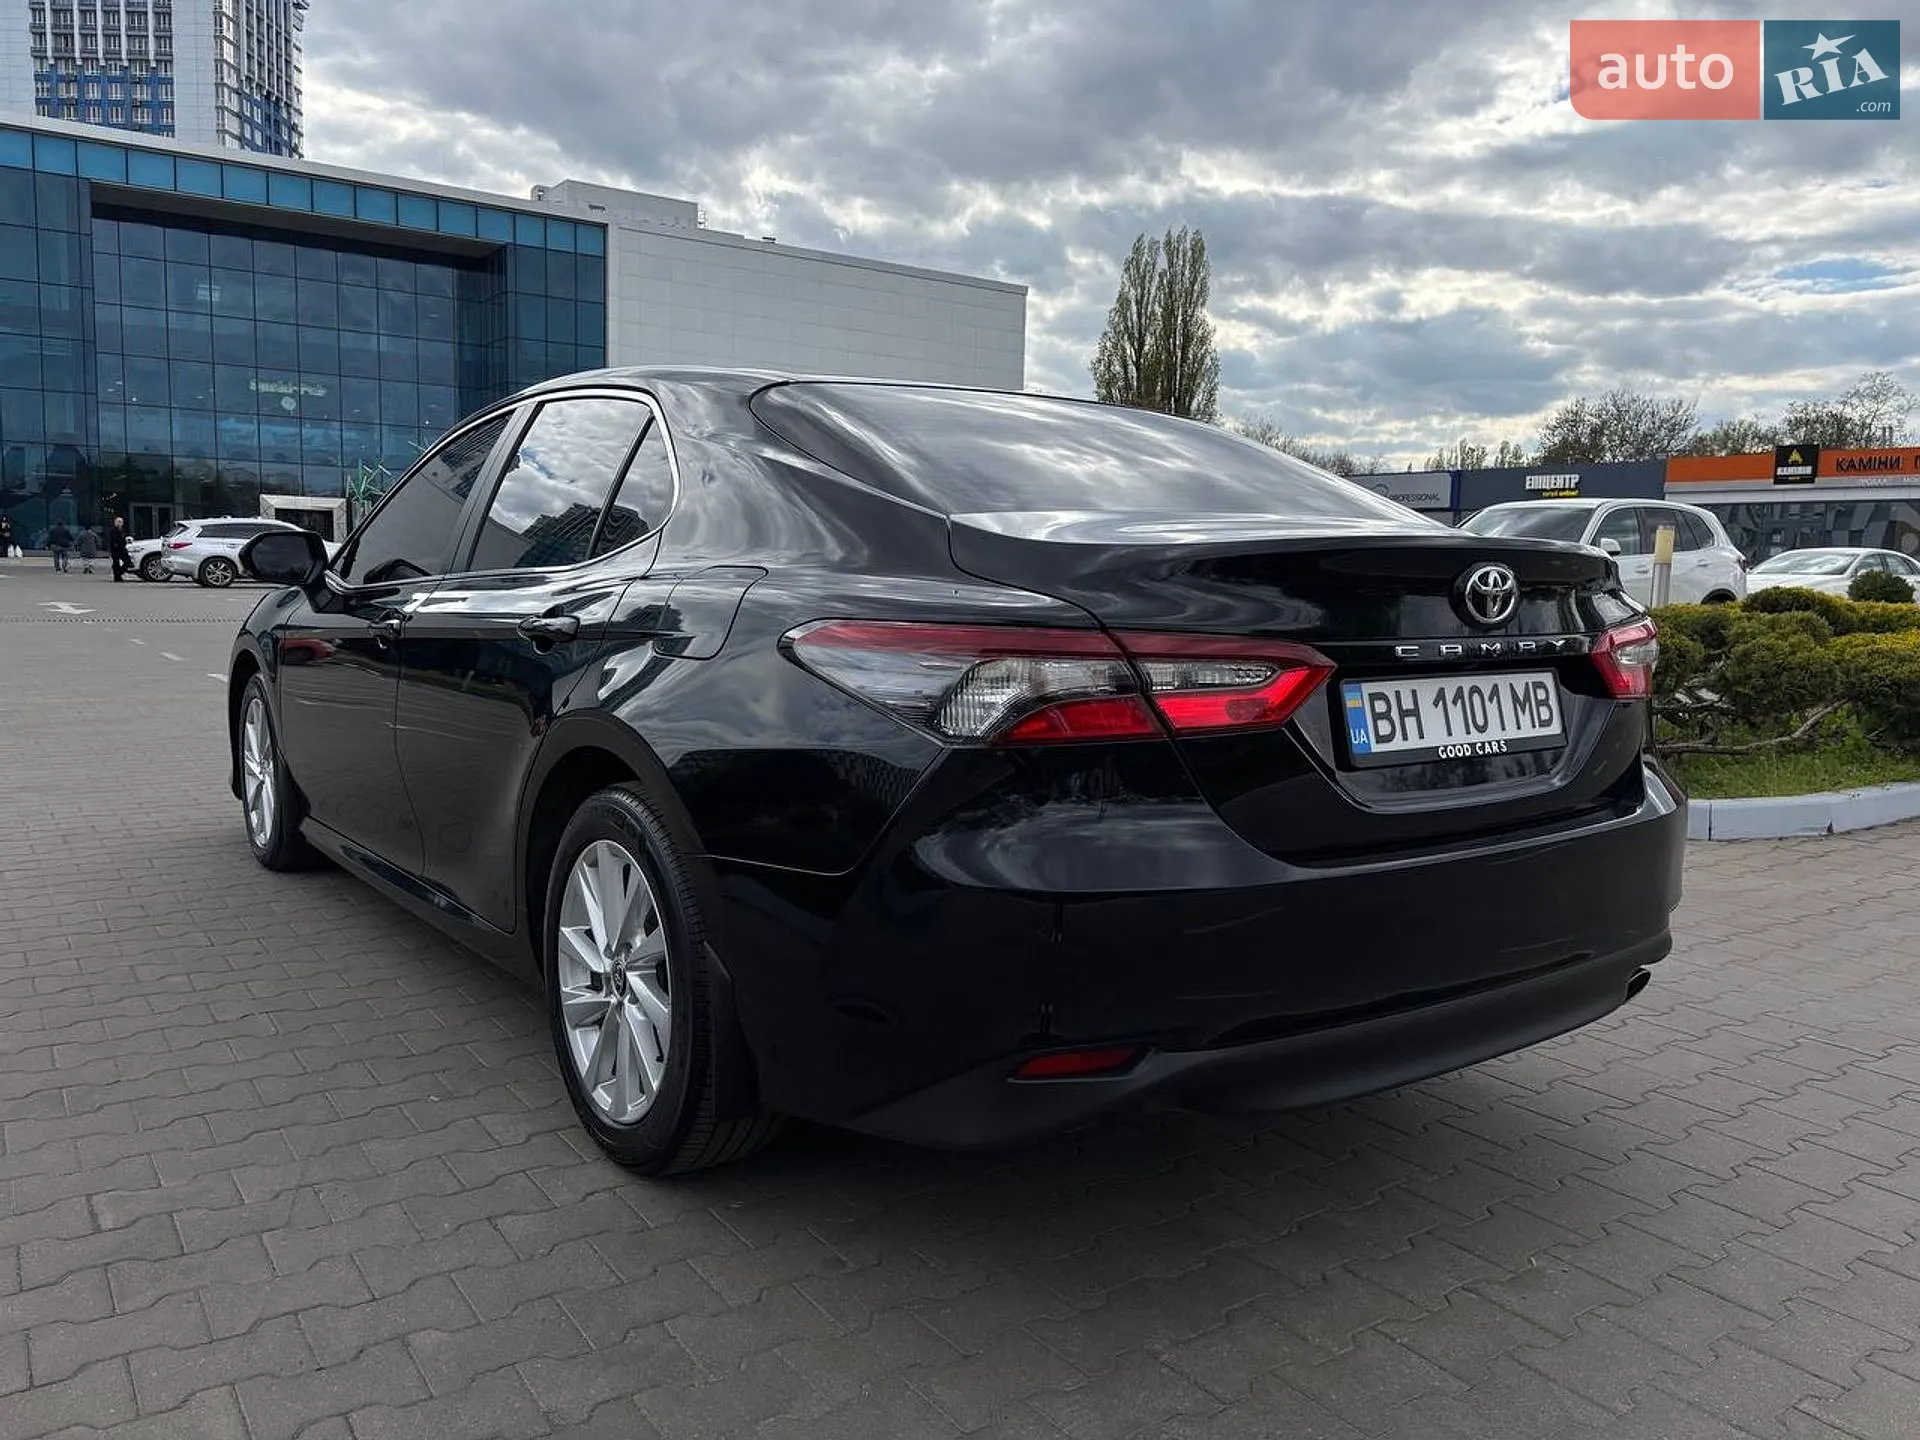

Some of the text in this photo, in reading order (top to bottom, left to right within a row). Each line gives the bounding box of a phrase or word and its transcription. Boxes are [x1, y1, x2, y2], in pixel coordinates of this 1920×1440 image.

[1836, 455, 1903, 472] КАМІНИ
[1395, 639, 1567, 657] CAMRY
[1368, 680, 1554, 744] BH 1101 MB
[1350, 728, 1368, 745] UA
[1438, 740, 1508, 759] GOOD CARS
